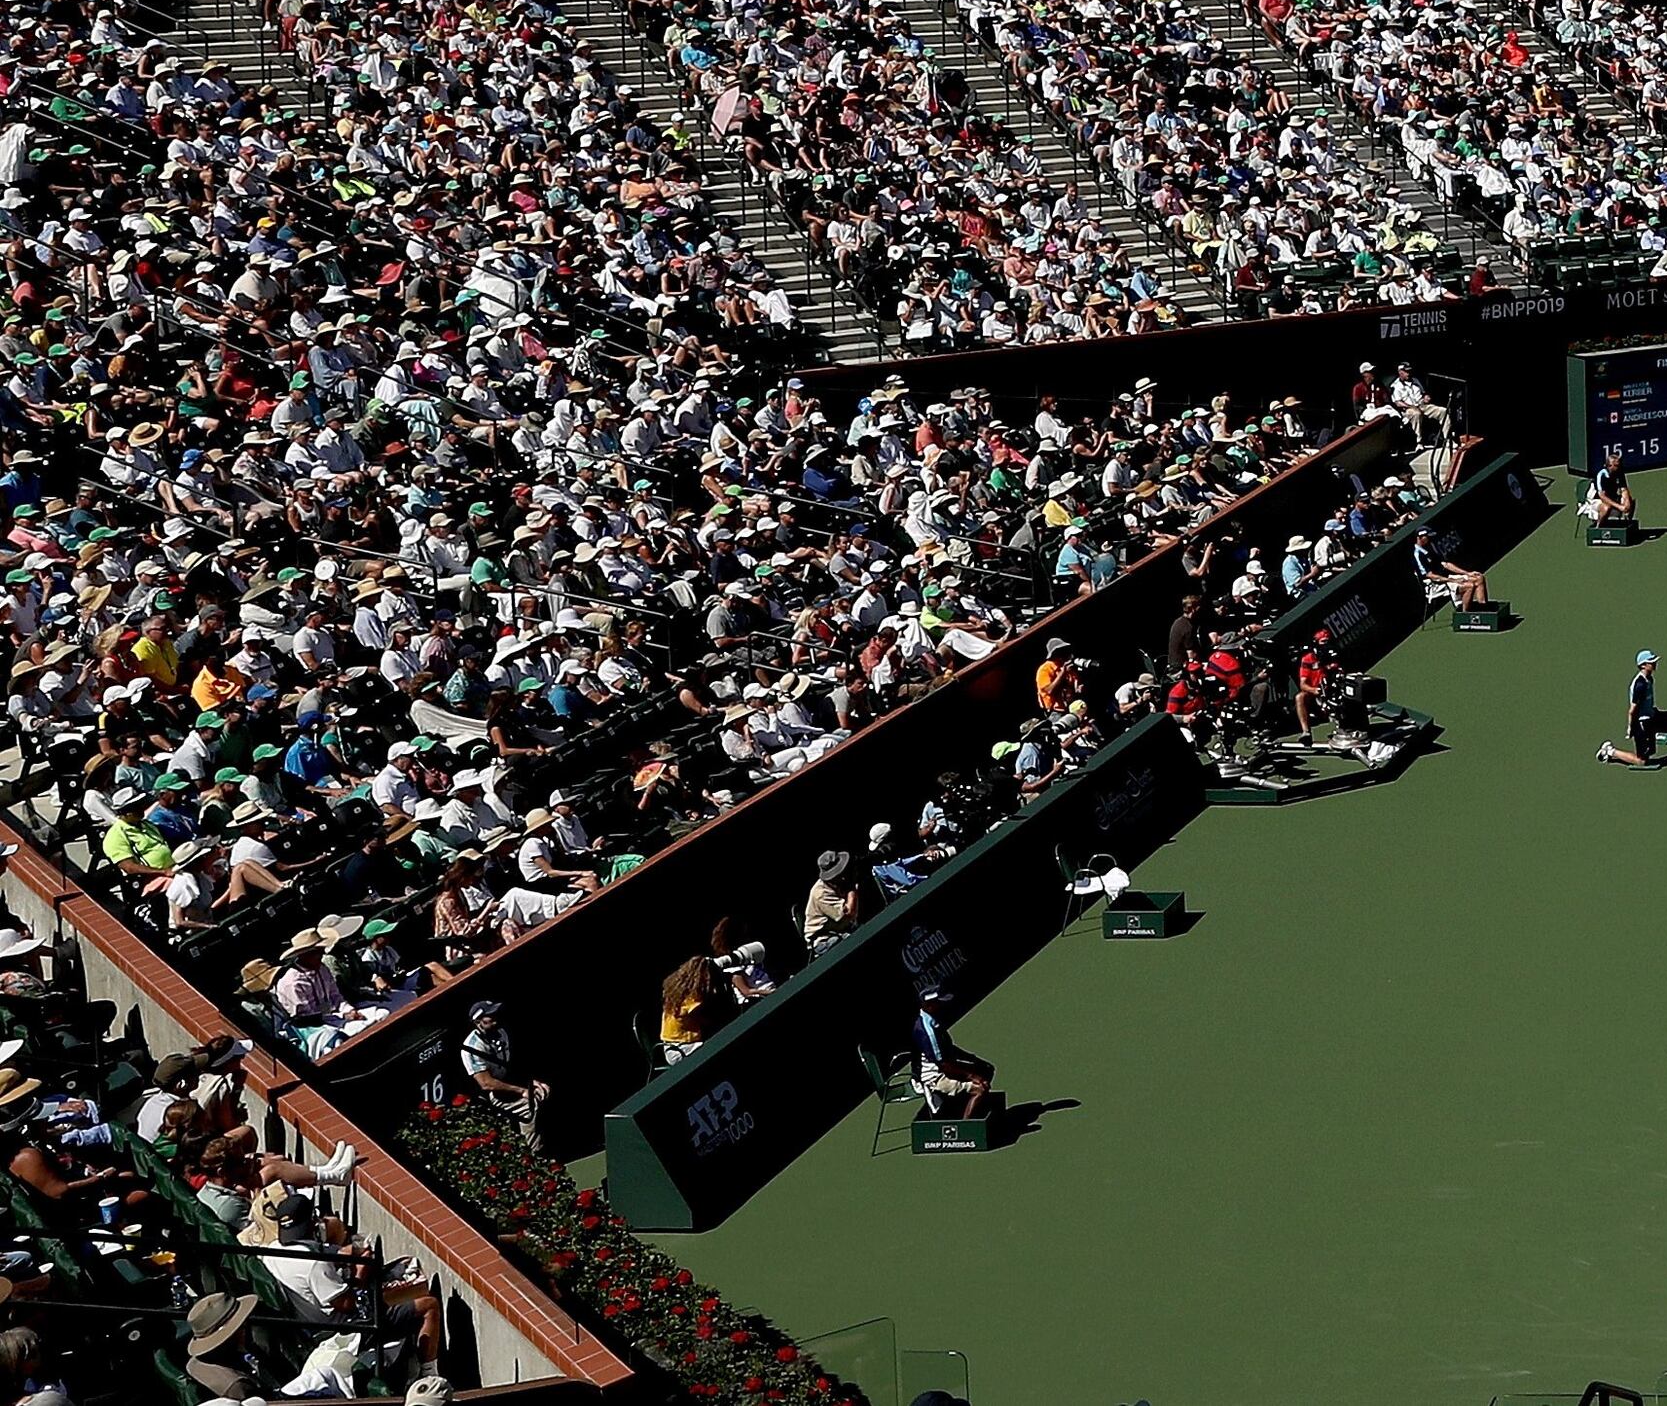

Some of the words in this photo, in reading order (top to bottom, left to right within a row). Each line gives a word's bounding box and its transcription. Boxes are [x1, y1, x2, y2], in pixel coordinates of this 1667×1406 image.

[1403, 311, 1447, 328] TENNIS
[1639, 438, 1660, 456] 15
[1113, 928, 1128, 936] BNP
[1129, 928, 1155, 936] PARIBAS
[902, 930, 949, 973] Corona
[420, 1073, 444, 1103] 16
[687, 1081, 738, 1147] ATP
[924, 1141, 943, 1149] BNP
[944, 1140, 976, 1149] PARIBAS
